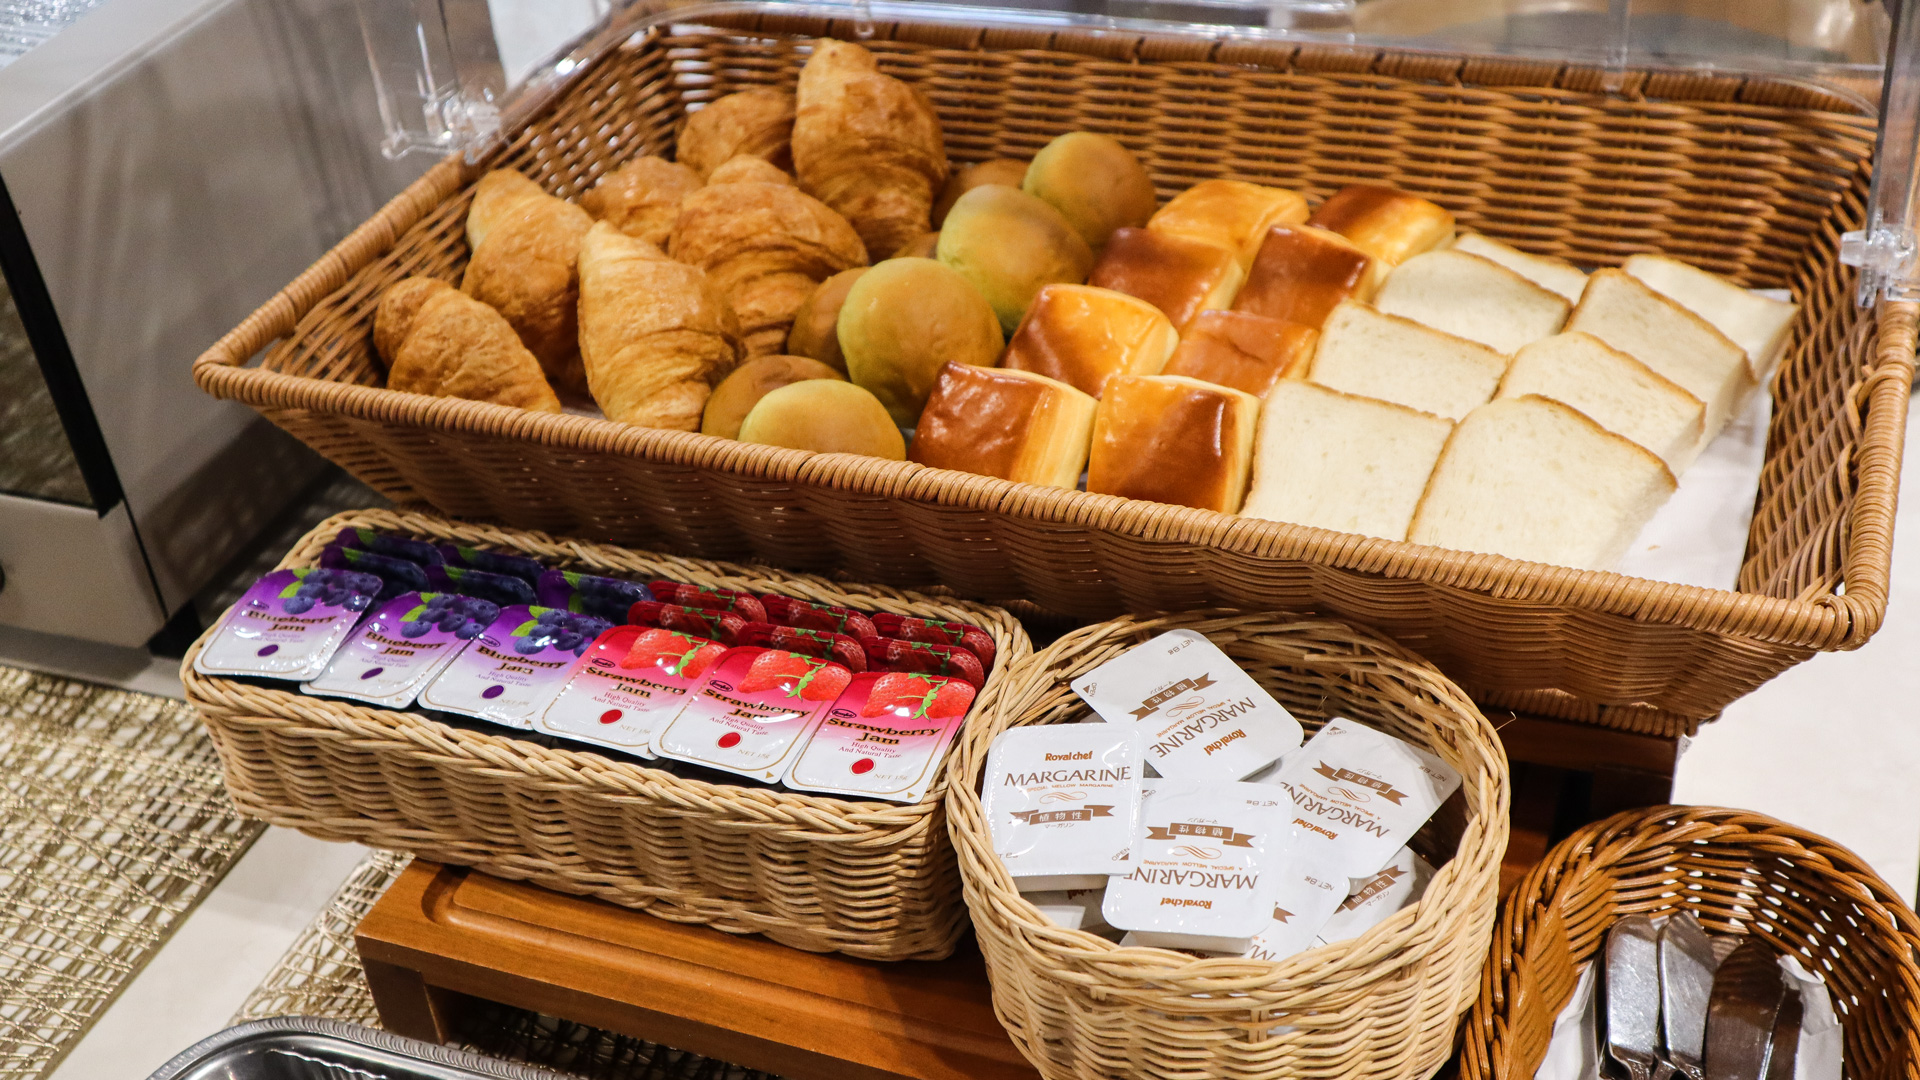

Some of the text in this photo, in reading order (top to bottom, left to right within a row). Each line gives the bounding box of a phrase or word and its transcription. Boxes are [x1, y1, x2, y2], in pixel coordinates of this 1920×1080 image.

[247, 610, 338, 625] Blueberry
[267, 623, 306, 632] Jam
[365, 631, 447, 649] Blueberry
[379, 647, 415, 656] Jam
[475, 645, 568, 669] Blueberry
[586, 666, 688, 695] Strawberry
[609, 682, 651, 699] Jam
[591, 695, 650, 713] And Natural Taste
[604, 691, 646, 707] High Quality
[702, 688, 812, 718] Strawberry
[1207, 701, 1226, 710] SPECIAL
[1186, 709, 1206, 720] MELLOW
[709, 716, 769, 736] And Natural Taste
[722, 715, 765, 731] High Quality
[825, 717, 942, 737] Strawberry
[1149, 697, 1256, 758] MARGARINE
[1156, 719, 1185, 738] MARGARINE
[855, 732, 901, 745] Jam
[737, 749, 755, 757] NET
[838, 746, 855, 754] And
[856, 748, 882, 758] Natural
[851, 741, 897, 754] High Quality
[1004, 766, 1132, 787] MARGARINE
[1299, 783, 1328, 801] MARGARINE
[1330, 799, 1352, 808] MELLOW
[1039, 811, 1083, 822] 植物性
[1354, 806, 1375, 817] SPECIAL
[1178, 824, 1224, 837] 植物性
[1111, 847, 1131, 862] OPEN
[1143, 859, 1179, 867] MARGARINE
[1181, 861, 1208, 869] MELLOW
